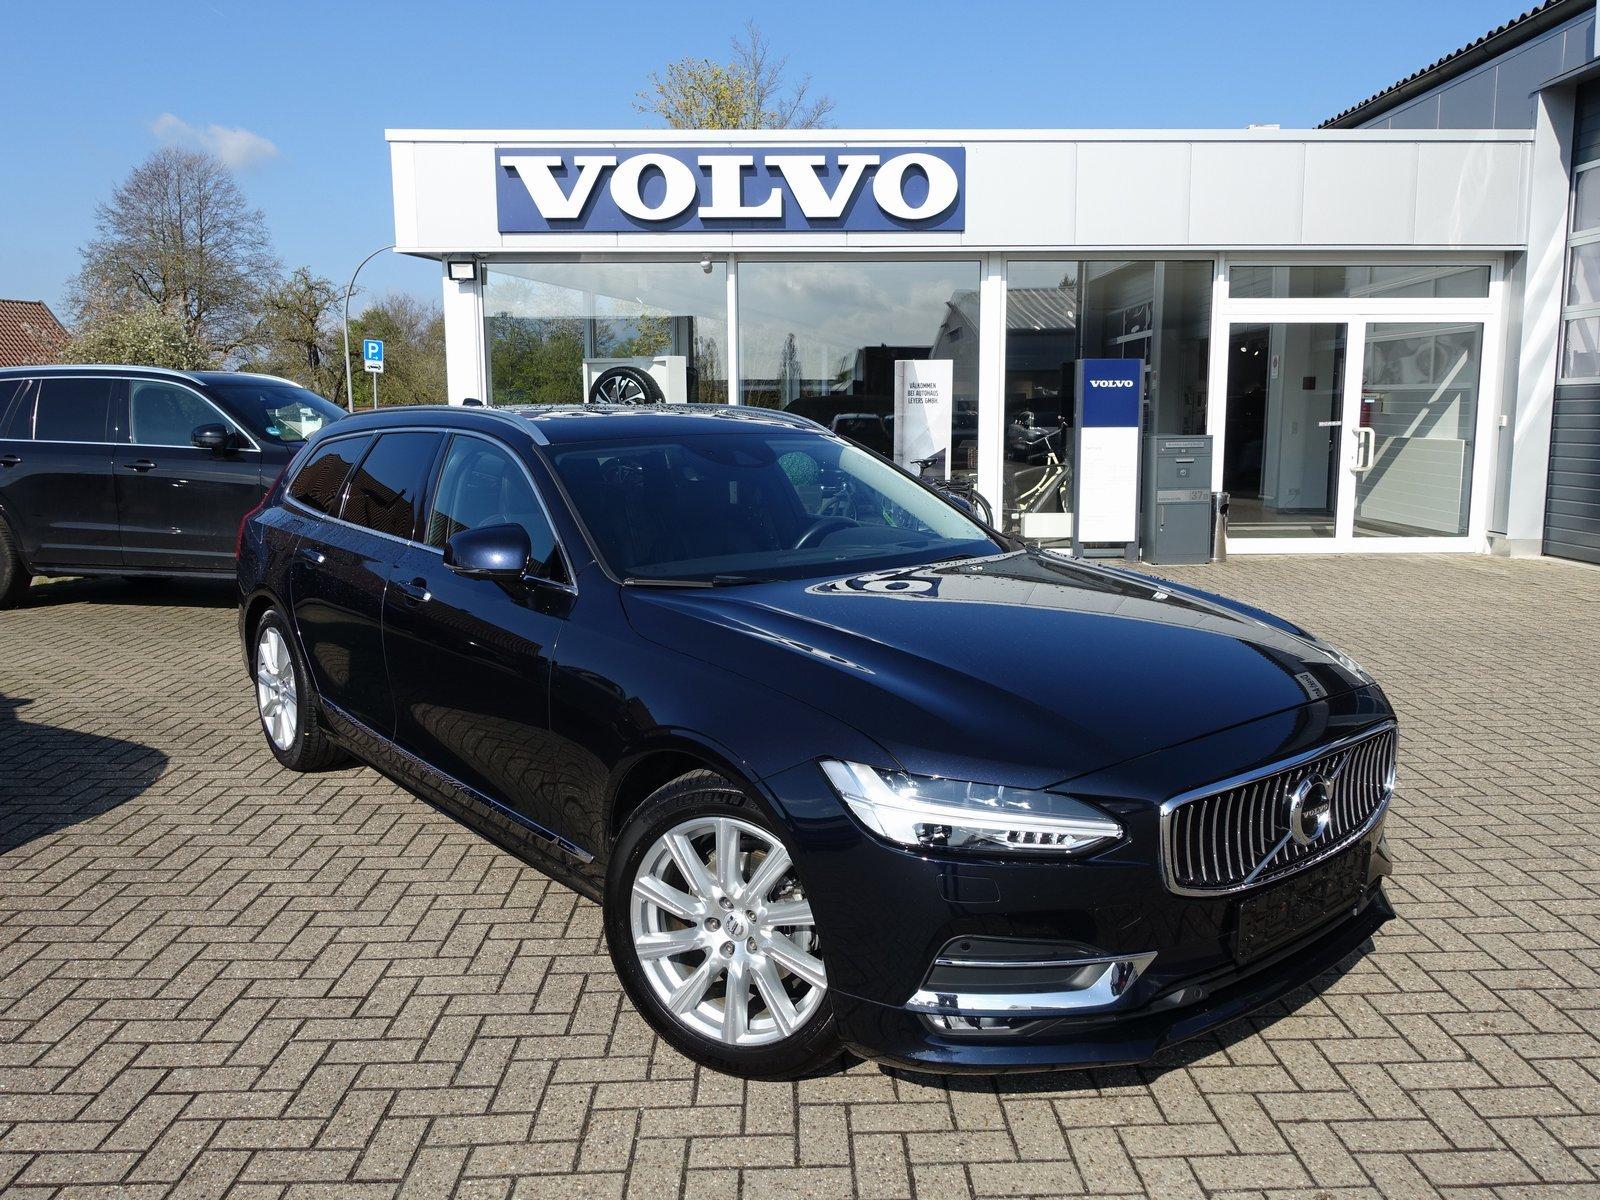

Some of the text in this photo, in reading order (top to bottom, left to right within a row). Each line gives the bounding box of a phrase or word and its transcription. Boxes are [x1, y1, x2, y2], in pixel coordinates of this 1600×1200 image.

[500, 153, 958, 220] VOLVO
[368, 342, 380, 359] P
[1090, 380, 1134, 388] VOLVO
